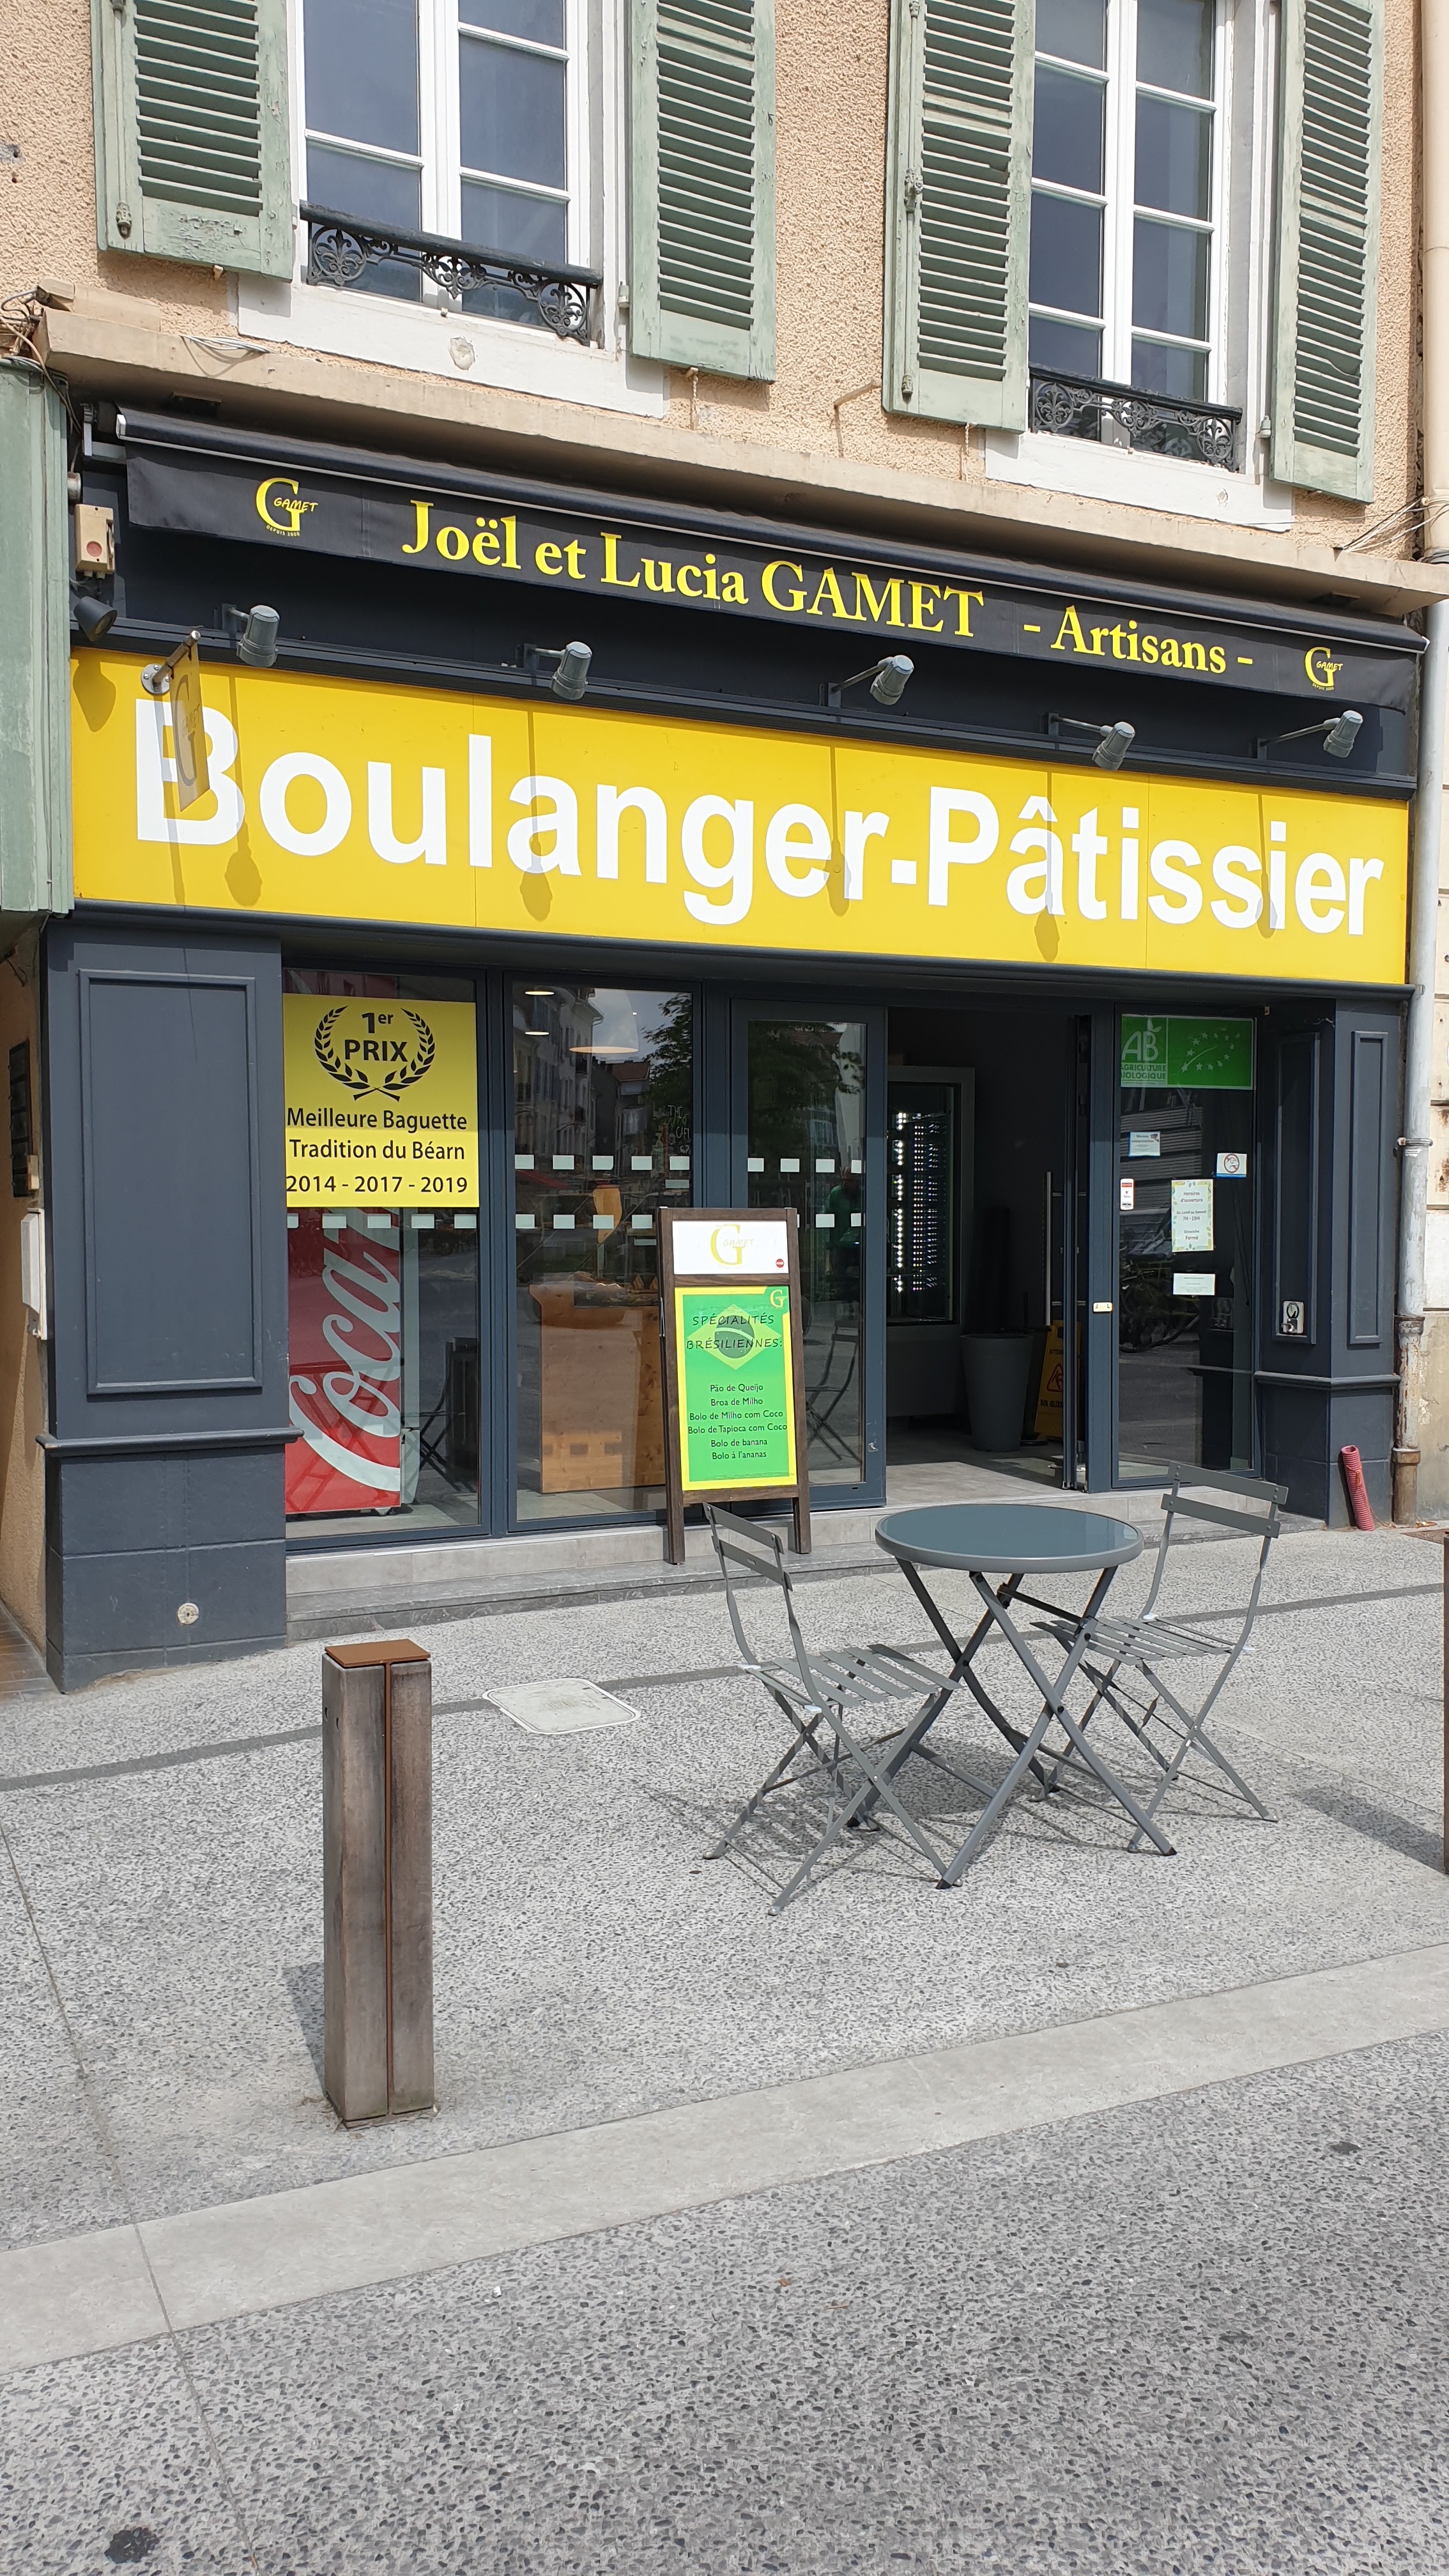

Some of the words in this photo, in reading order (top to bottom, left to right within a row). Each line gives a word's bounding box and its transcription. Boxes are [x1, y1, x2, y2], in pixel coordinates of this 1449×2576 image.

[256, 477, 300, 532] G
[273, 497, 319, 512] GAMET
[266, 525, 286, 537] DEPUIS
[402, 500, 521, 570] Joël
[535, 539, 586, 579] et
[601, 532, 749, 604] Lucia
[762, 560, 985, 637] GAMET
[1023, 624, 1041, 633] -
[1051, 605, 1227, 674] Artisans
[1305, 647, 1333, 686] G
[1316, 661, 1343, 671] GAMET
[362, 1012, 394, 1034] 1er
[344, 1039, 408, 1062] PRIX
[1121, 1031, 1159, 1061] AB
[287, 1107, 378, 1128] Meilleure
[383, 1110, 467, 1134] Baguette
[289, 1139, 376, 1158] Tradition
[383, 1140, 406, 1160] du
[413, 1141, 464, 1160] Béarn
[286, 1176, 336, 1193] 2014
[355, 1176, 402, 1193] 2017
[420, 1177, 468, 1193] 2019
[710, 1223, 742, 1266] G
[723, 1239, 755, 1247] GAMET
[770, 1289, 783, 1308] G
[693, 1312, 774, 1326] SPÉCIALITÉS
[686, 1337, 783, 1349] BRÉSILIENNES:
[710, 1384, 724, 1393] Pão
[738, 1383, 763, 1393] Queijo
[742, 1397, 763, 1406] Milho
[688, 1426, 705, 1434] Bolo
[719, 1425, 746, 1434] Tapioca
[712, 1452, 730, 1460] Bolo
